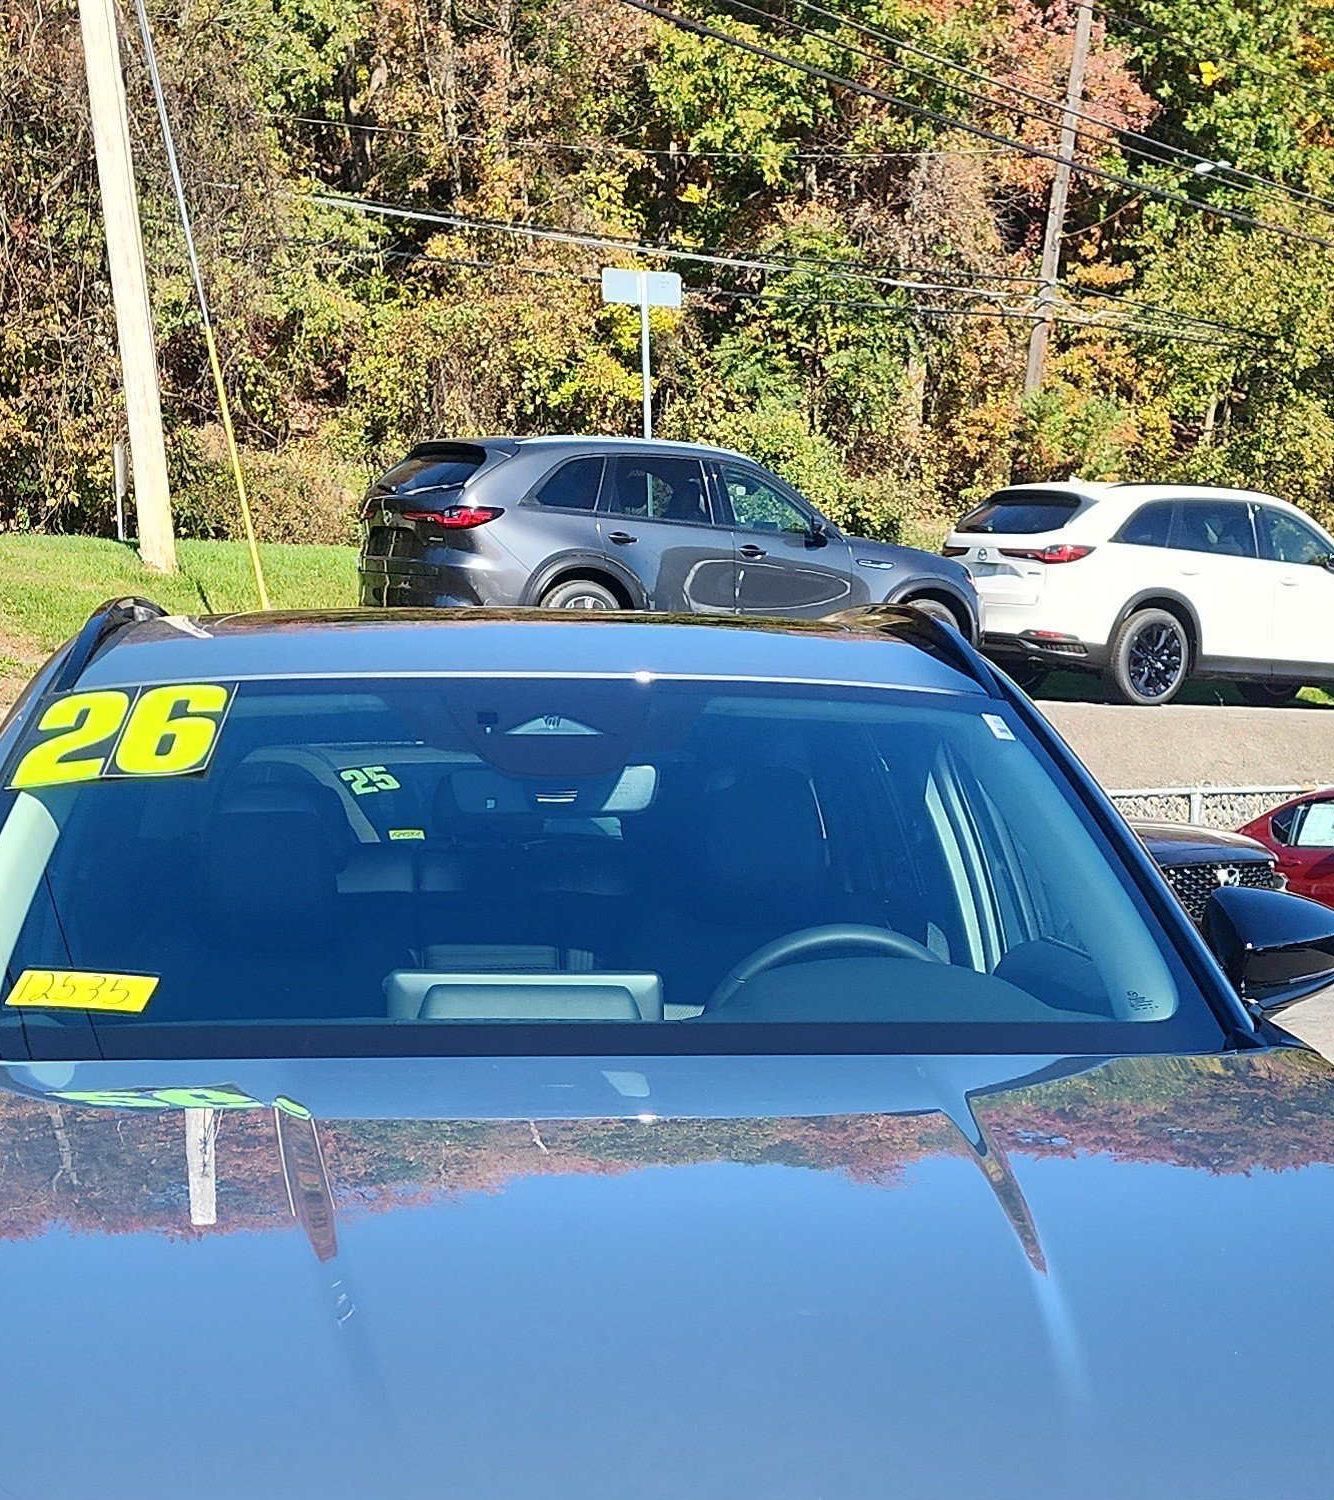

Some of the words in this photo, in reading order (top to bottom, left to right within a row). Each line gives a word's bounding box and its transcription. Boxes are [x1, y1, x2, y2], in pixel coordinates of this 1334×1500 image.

[11, 684, 228, 787] 26
[340, 766, 401, 796] 25
[17, 972, 130, 1005] 12535
